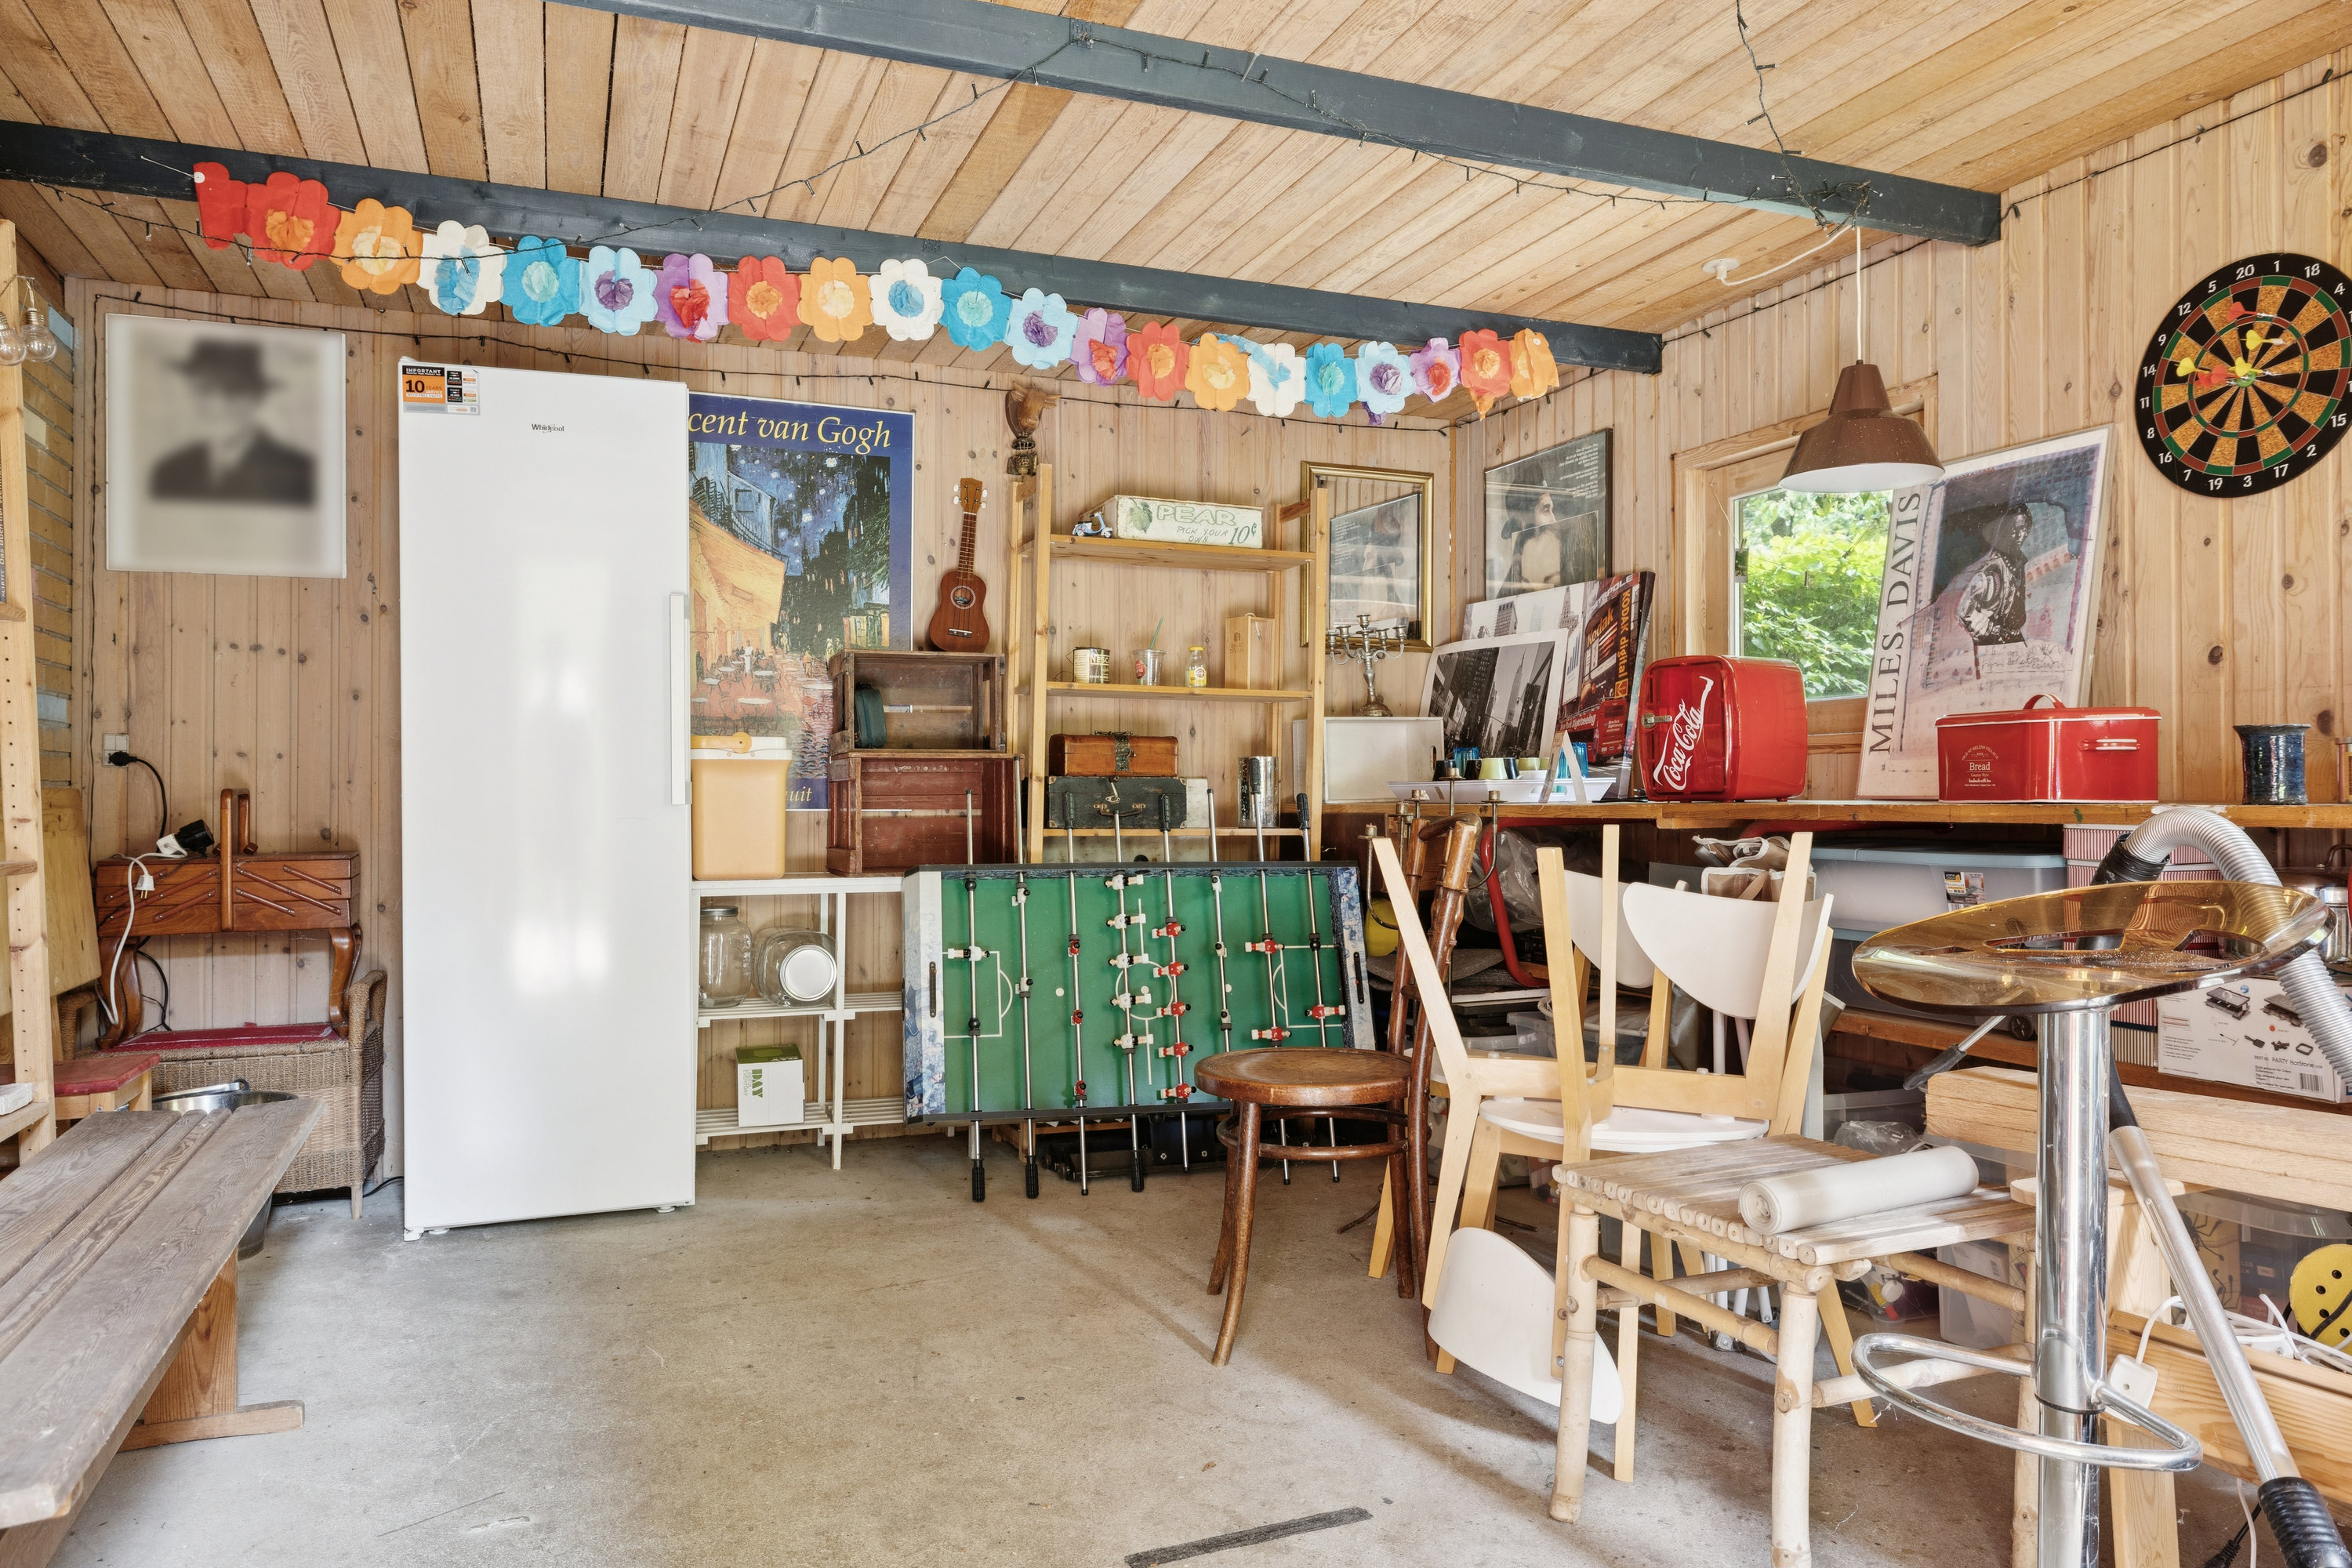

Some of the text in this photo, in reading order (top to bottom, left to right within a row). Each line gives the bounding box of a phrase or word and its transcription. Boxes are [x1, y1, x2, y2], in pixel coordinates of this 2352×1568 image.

[2236, 264, 2255, 279] 20
[2274, 260, 2280, 272] 1
[2303, 263, 2321, 278] 18
[2208, 280, 2217, 293] 5
[2334, 283, 2346, 296] 4
[2177, 302, 2192, 316] 12
[2158, 334, 2167, 346] 9
[2143, 365, 2156, 376] 14
[405, 379, 425, 394] 10
[2140, 396, 2150, 408] 11
[2331, 413, 2347, 427] 15
[532, 423, 564, 433] Whirlpool
[688, 411, 891, 455] cent van Gogh
[2147, 427, 2155, 439] 8
[2307, 445, 2317, 457] 2
[2158, 452, 2172, 464] 16
[2183, 470, 2192, 481] 7
[2274, 464, 2288, 478] 17
[2209, 478, 2223, 490] 19
[2243, 476, 2252, 487] 3
[1156, 505, 1236, 526] PEAR
[1177, 526, 1229, 537] PICK YOUR
[1587, 608, 1613, 648] Kodak
[1870, 492, 1921, 755] MILES DAVIS
[1617, 589, 1631, 678] KODAK digital
[1658, 684, 1711, 790] Coca-Cola
[1969, 761, 1991, 771] Bread
[786, 786, 812, 802] uit
[752, 1069, 763, 1098] DAY
